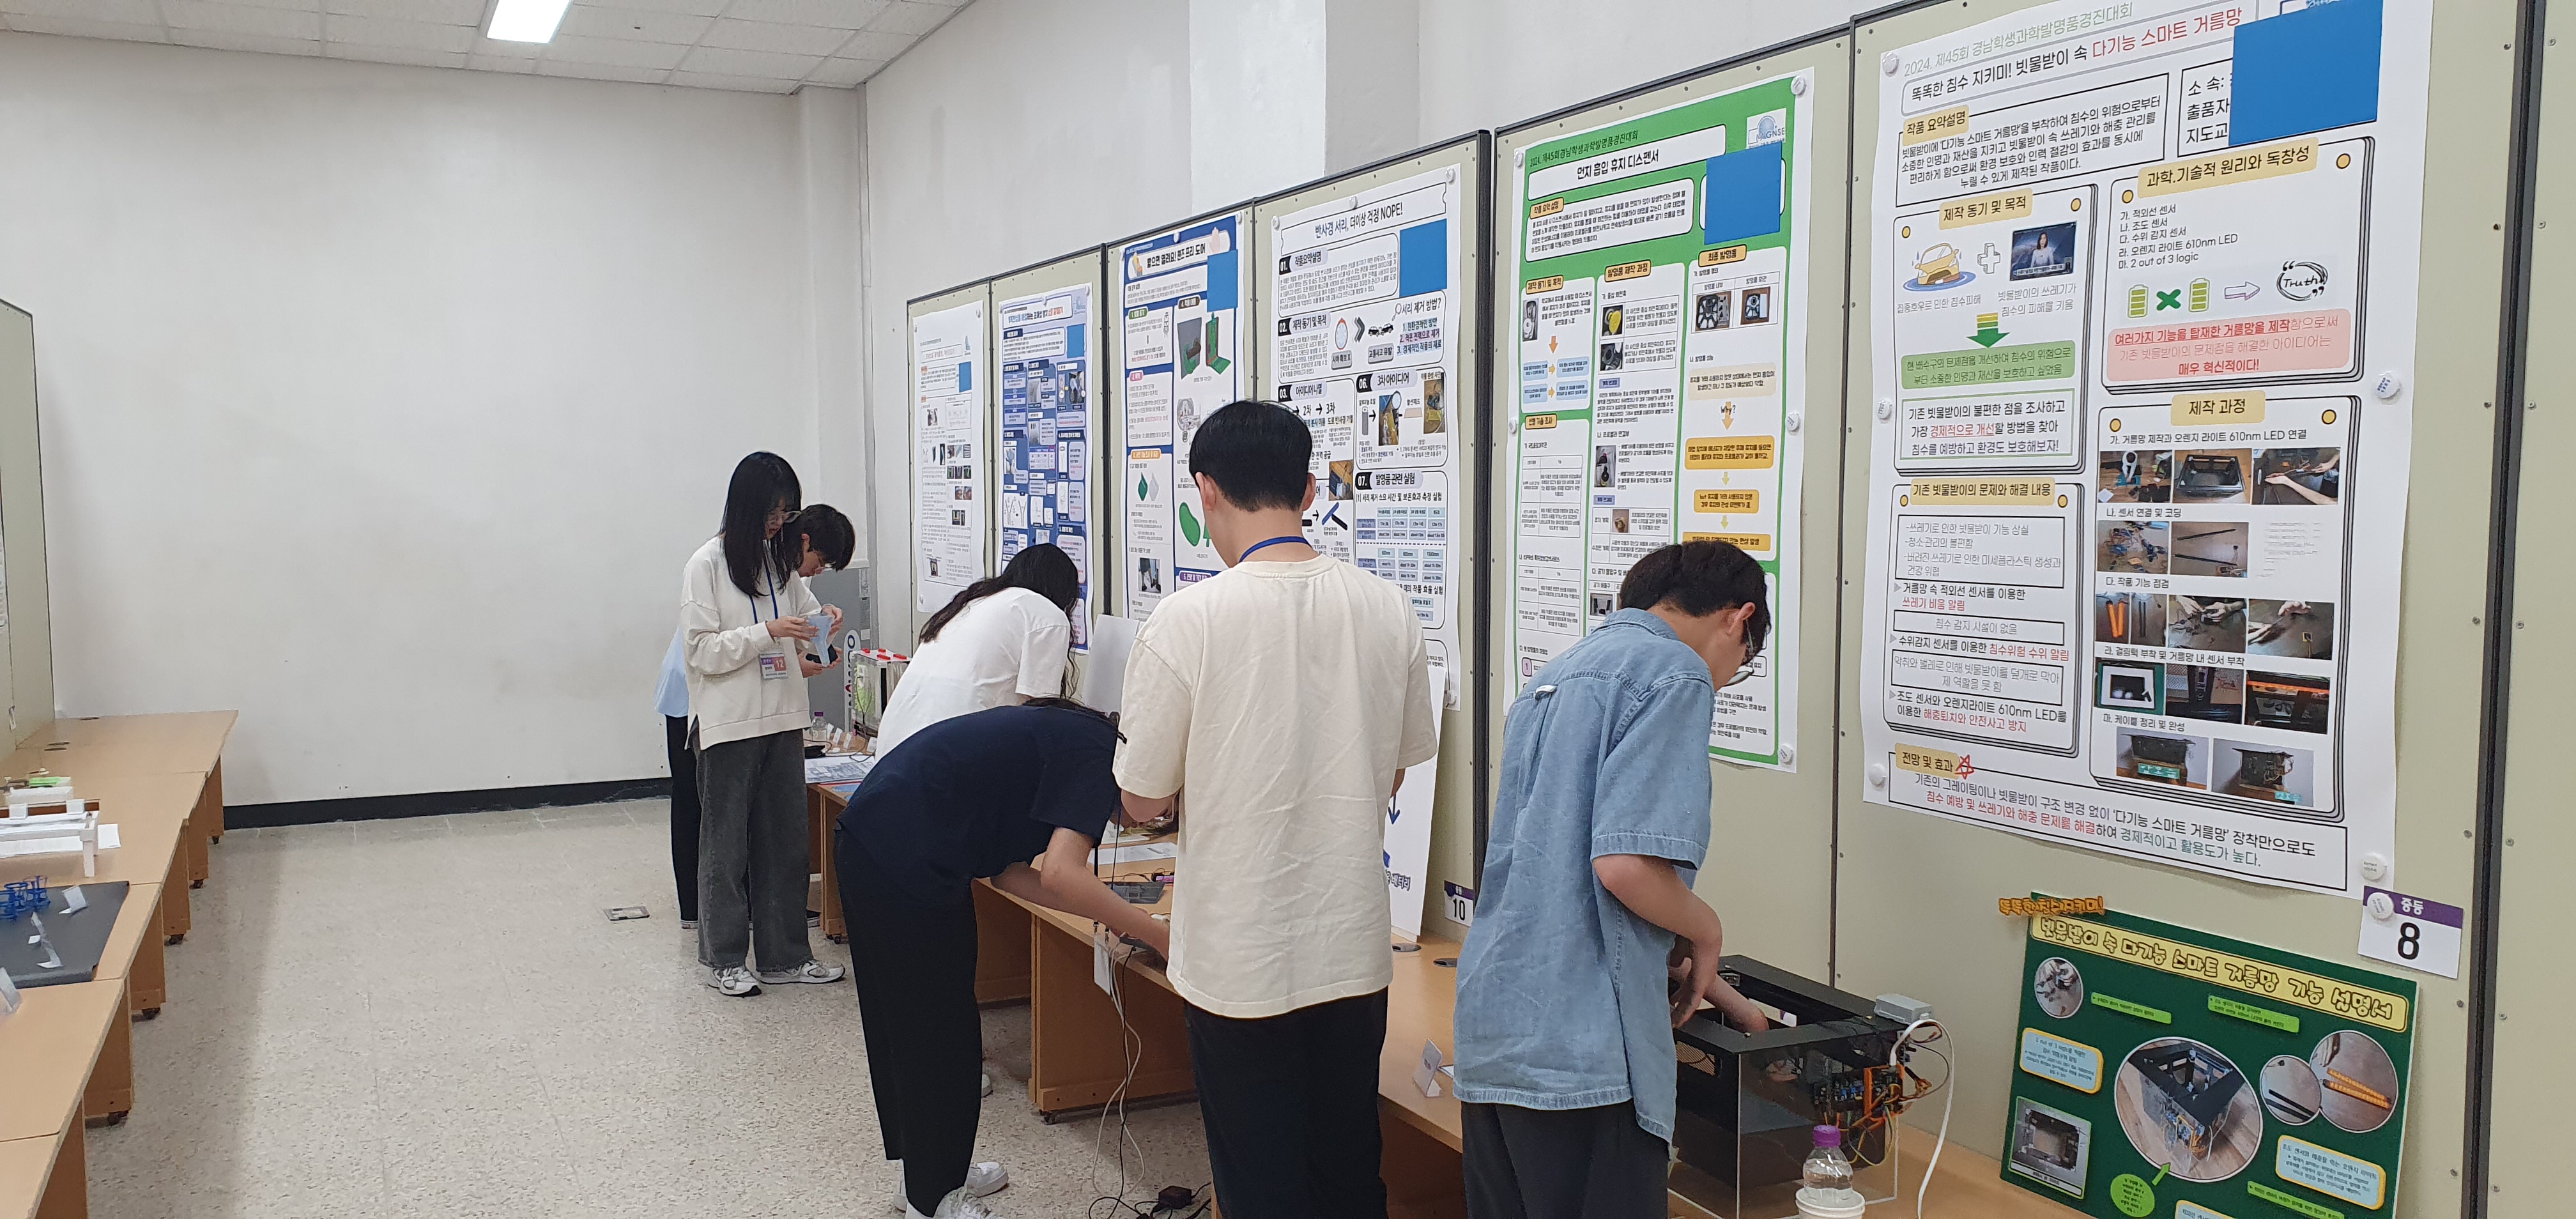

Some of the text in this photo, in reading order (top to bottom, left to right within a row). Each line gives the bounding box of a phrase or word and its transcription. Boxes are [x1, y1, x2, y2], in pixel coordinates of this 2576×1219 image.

[1905, 2, 2132, 77] 2024. 제45회 경남학생과학발명품경진대회
[1912, 7, 2242, 101] 똑똑한 침수 지키미! 빗물받이 속 다기능 스마트 거름망
[2188, 81, 2201, 96] 소
[2188, 97, 2229, 121] 출품자
[1903, 142, 1938, 159] 빗물받이에
[1967, 130, 1991, 144] 스마트
[2032, 114, 2067, 132] 부착하여
[2071, 108, 2098, 124] 침수의
[2102, 95, 2160, 118] 위험으로부터
[1907, 111, 1965, 135] 작품 요약설명
[1902, 112, 2156, 172] 소중한 인명과 재산을 지키고 빗물받이 속 쓰레기와 해충 관리를
[2186, 123, 2230, 143] 지도교
[1577, 149, 1659, 180] 먼지 흡입 휴지 디스펜서
[1910, 131, 2143, 184] 편리하게 함으로써 환경 보호와 인력 절감의 효과를 동시에
[2147, 146, 2309, 187] 과학.기술적 원리와 독창성
[1961, 157, 2080, 188] 누릴 수 있게 제작된 작품이다.
[1943, 195, 2025, 220] 제작 동기 및 목적
[2120, 204, 2175, 220] 가. 적외선 센서
[1315, 202, 1402, 238] 반사경 서리, 더이상 걱정 NOPE!
[2120, 217, 2167, 232] 나. 조도 센서
[2120, 226, 2186, 243] 다. 수위 감지 센서
[2119, 234, 2237, 257] 라. 오렌지 라이트 610nm LED
[2131, 259, 2136, 268] 2
[2139, 257, 2154, 266] out
[2156, 256, 2165, 264] of
[2168, 255, 2174, 263] 3
[2177, 252, 2198, 264] logic
[2283, 275, 2319, 289] Truth
[1401, 302, 1412, 315] 서리
[2179, 358, 2259, 374] 매우 혁신적이다!
[1359, 378, 1368, 388] 06.
[1386, 372, 1409, 385] 아이디어
[1303, 405, 1311, 416] 2차
[1326, 402, 1335, 414] 3차
[1909, 401, 2065, 419] 기존 빗물받이의 불편한 점을 조사하고
[2189, 399, 2245, 415] 제작 과정
[1912, 420, 2058, 438] 가장 경제적으로 개선할 방법을 찾아
[1912, 440, 2058, 456] 침수를 예방하고 환경도 보호해보자!
[1358, 475, 1367, 486] 07.
[1376, 473, 1414, 485] 발명품 관련 실험
[1913, 484, 2050, 496] 기존 빗물받이의 문제와 해결 내용
[1903, 752, 1953, 772] 전망 및 효과
[1915, 773, 1940, 788] 기존의
[1942, 777, 1996, 799] 그레이팅이나
[1999, 789, 2037, 807] 빗물받이
[2041, 797, 2060, 811] 구조
[2064, 801, 2084, 815] 변경
[2089, 806, 2109, 820] 없이
[2152, 817, 2186, 834] 스마트
[2234, 831, 2315, 856] 장착만으로도
[1392, 874, 1411, 891] 배터리
[1453, 898, 1466, 921] 10
[2401, 898, 2424, 916] 중등
[2398, 923, 2419, 960] 8
[2041, 917, 2393, 1020] 빗물받이 속 다기능 스마트 거름망 기능 설명서
